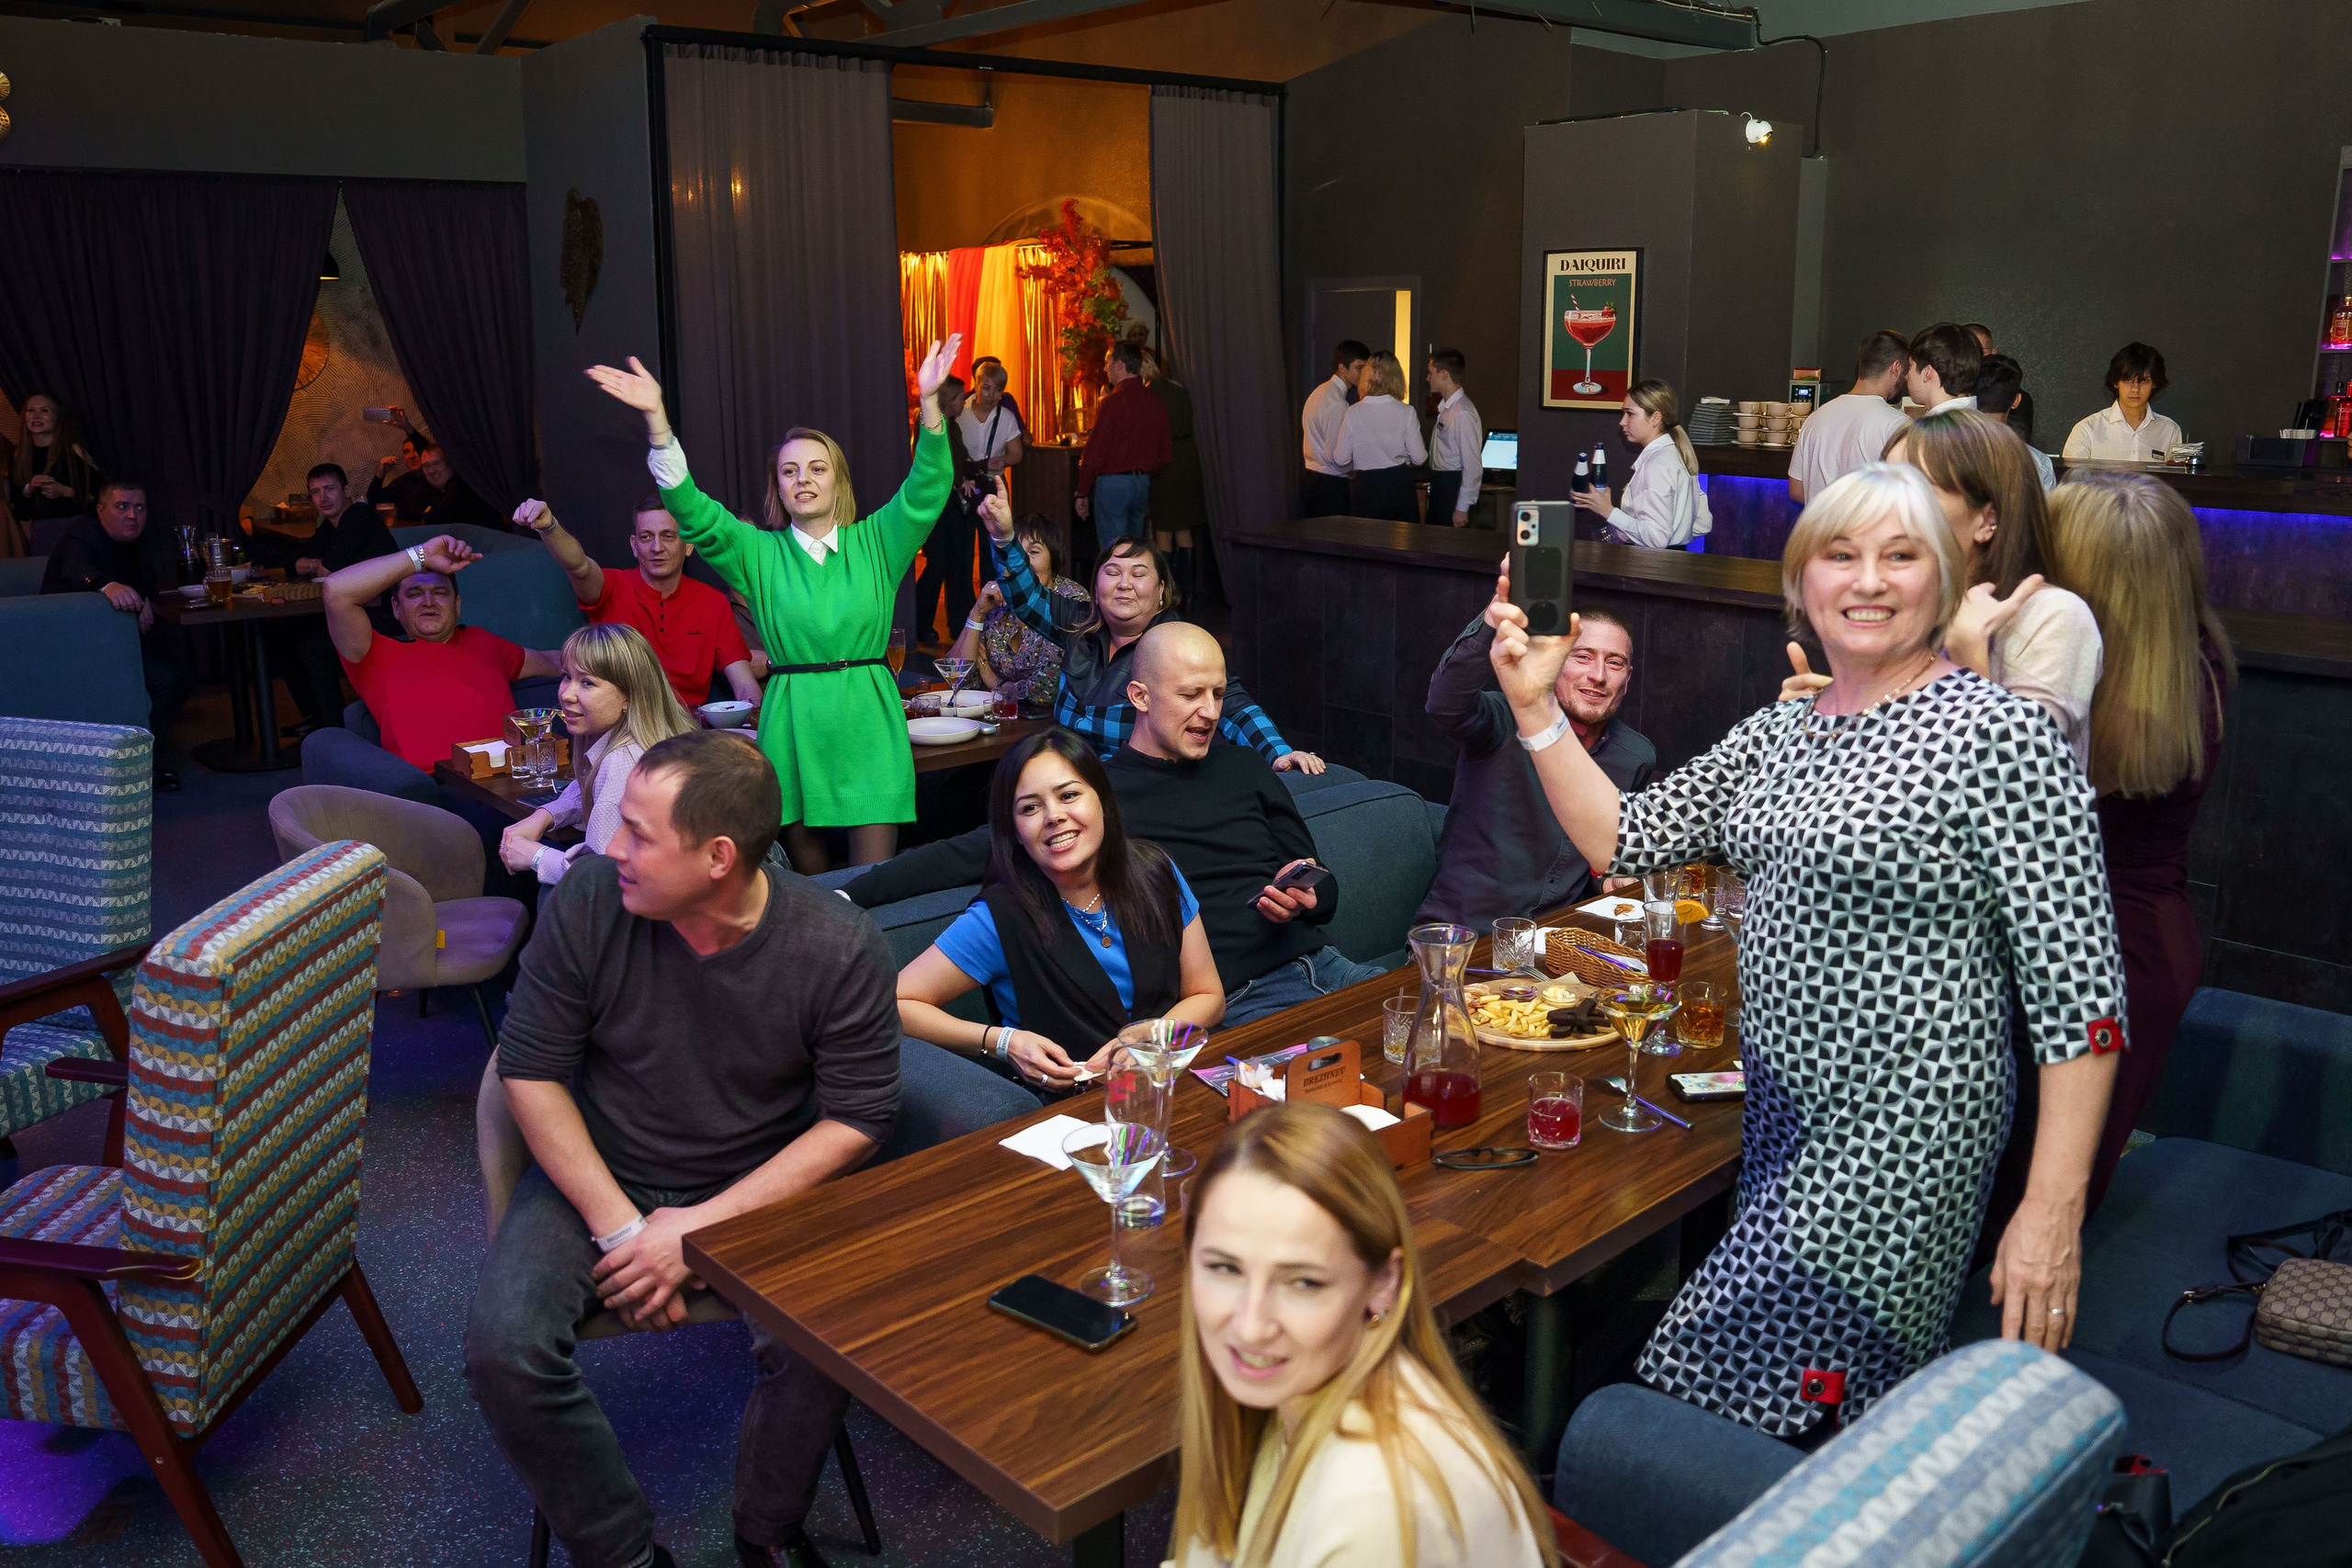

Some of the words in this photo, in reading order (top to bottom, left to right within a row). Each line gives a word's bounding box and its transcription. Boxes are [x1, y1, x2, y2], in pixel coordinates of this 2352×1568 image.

[1560, 257, 1626, 273] DAIQUIRI
[1568, 278, 1617, 288] STRAWBERRY
[1303, 1066, 1346, 1088] BREZHNEV
